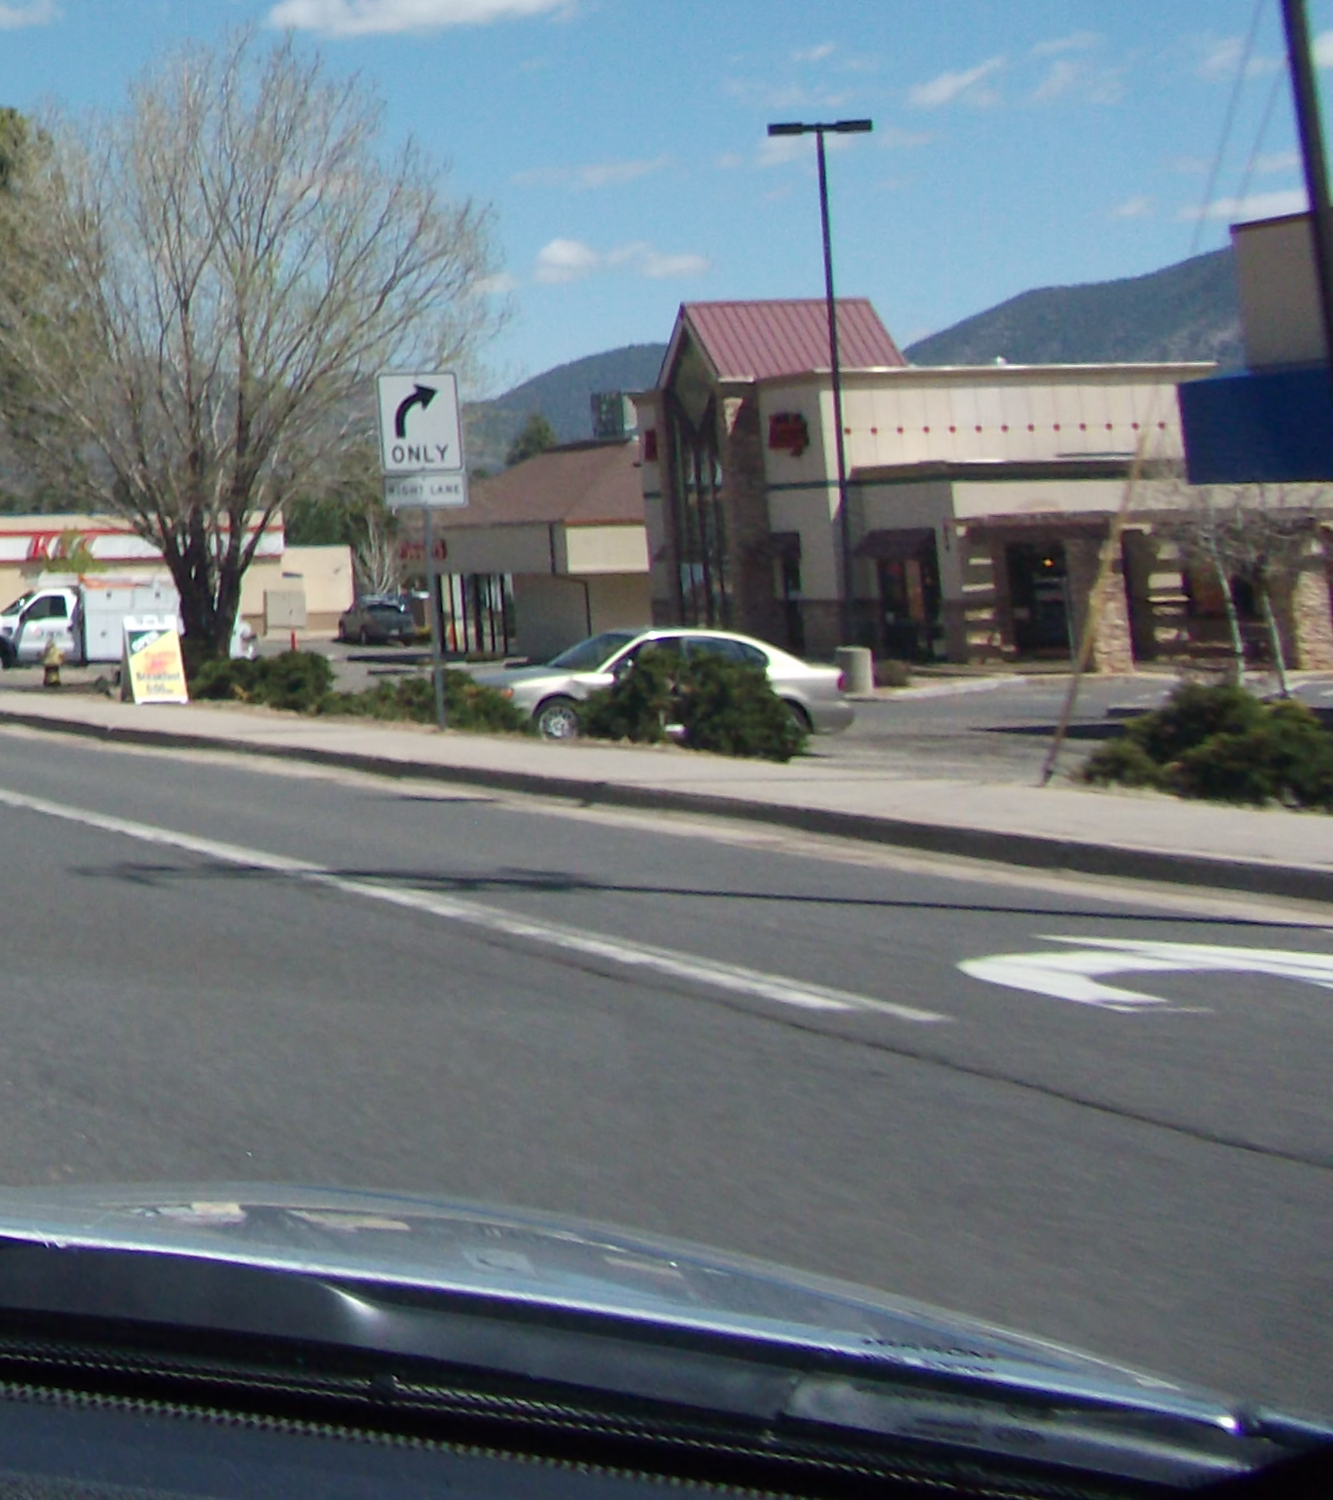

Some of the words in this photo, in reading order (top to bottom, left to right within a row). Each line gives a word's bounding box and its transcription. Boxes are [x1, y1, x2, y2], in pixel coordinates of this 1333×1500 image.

[392, 444, 448, 463] ONLY
[388, 484, 423, 496] RIGHT
[430, 484, 459, 495] LANE
